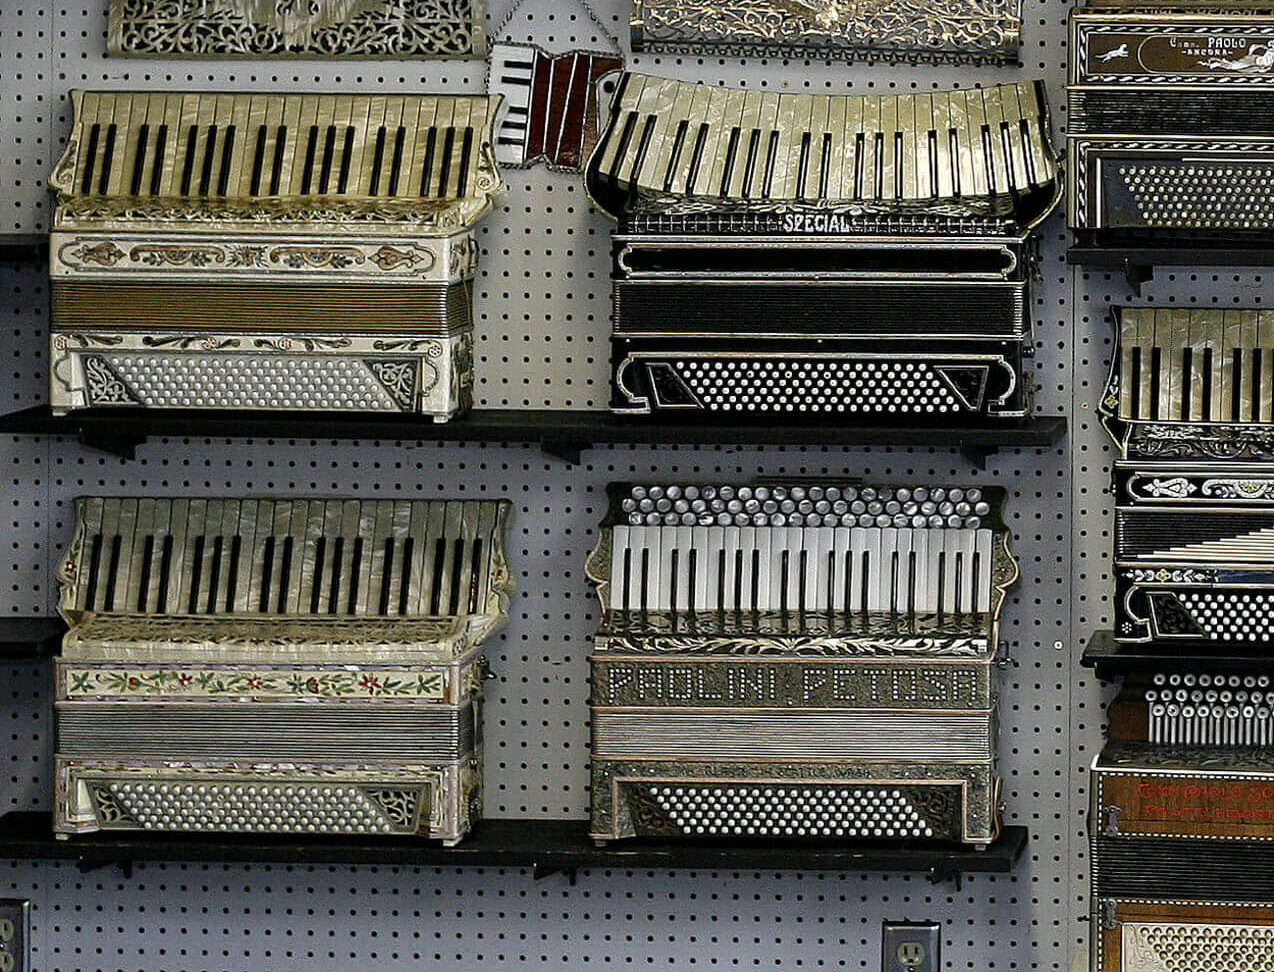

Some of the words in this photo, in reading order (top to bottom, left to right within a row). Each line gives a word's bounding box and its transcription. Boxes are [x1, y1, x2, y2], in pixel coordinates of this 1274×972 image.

[1208, 37, 1246, 48] PAOLO
[783, 214, 850, 233] SPECIAL
[608, 668, 777, 703] PAOLINI
[803, 669, 977, 701] PETOSA
